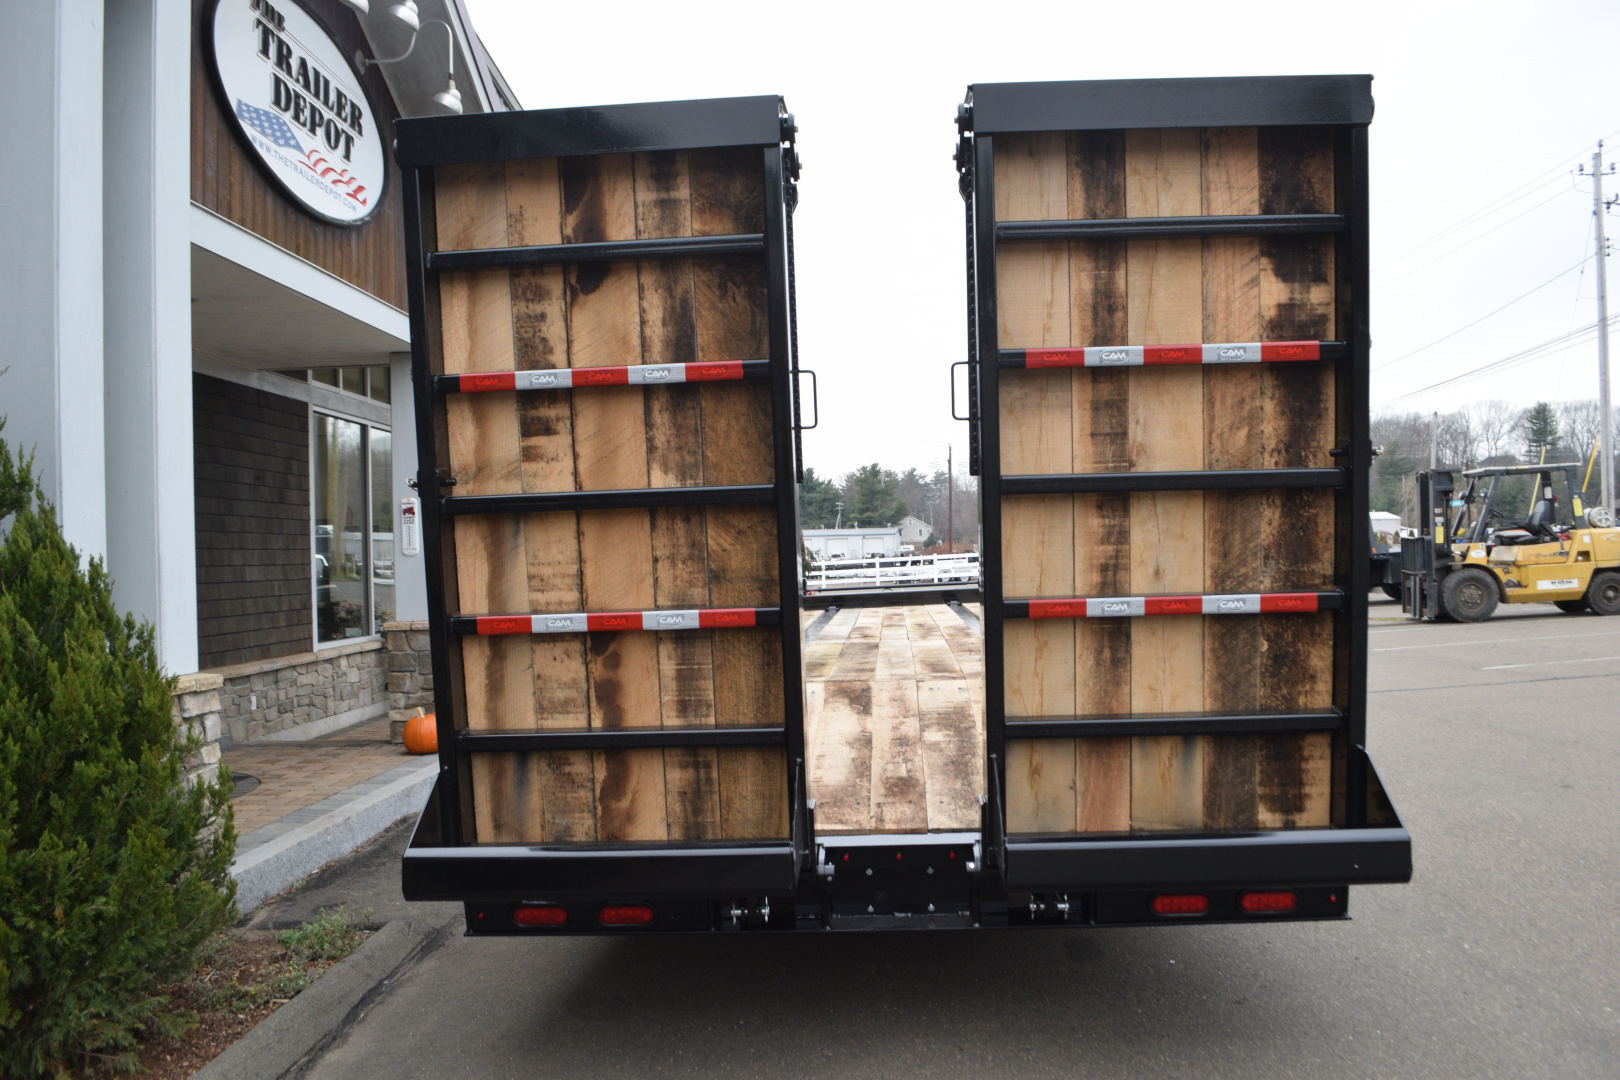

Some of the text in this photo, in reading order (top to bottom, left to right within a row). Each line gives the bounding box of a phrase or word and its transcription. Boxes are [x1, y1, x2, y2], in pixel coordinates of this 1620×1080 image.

[254, 17, 363, 138] TRAILER
[271, 73, 355, 163] DEPOT
[250, 133, 357, 213] WWW.THETRAILERDEPOT.COM
